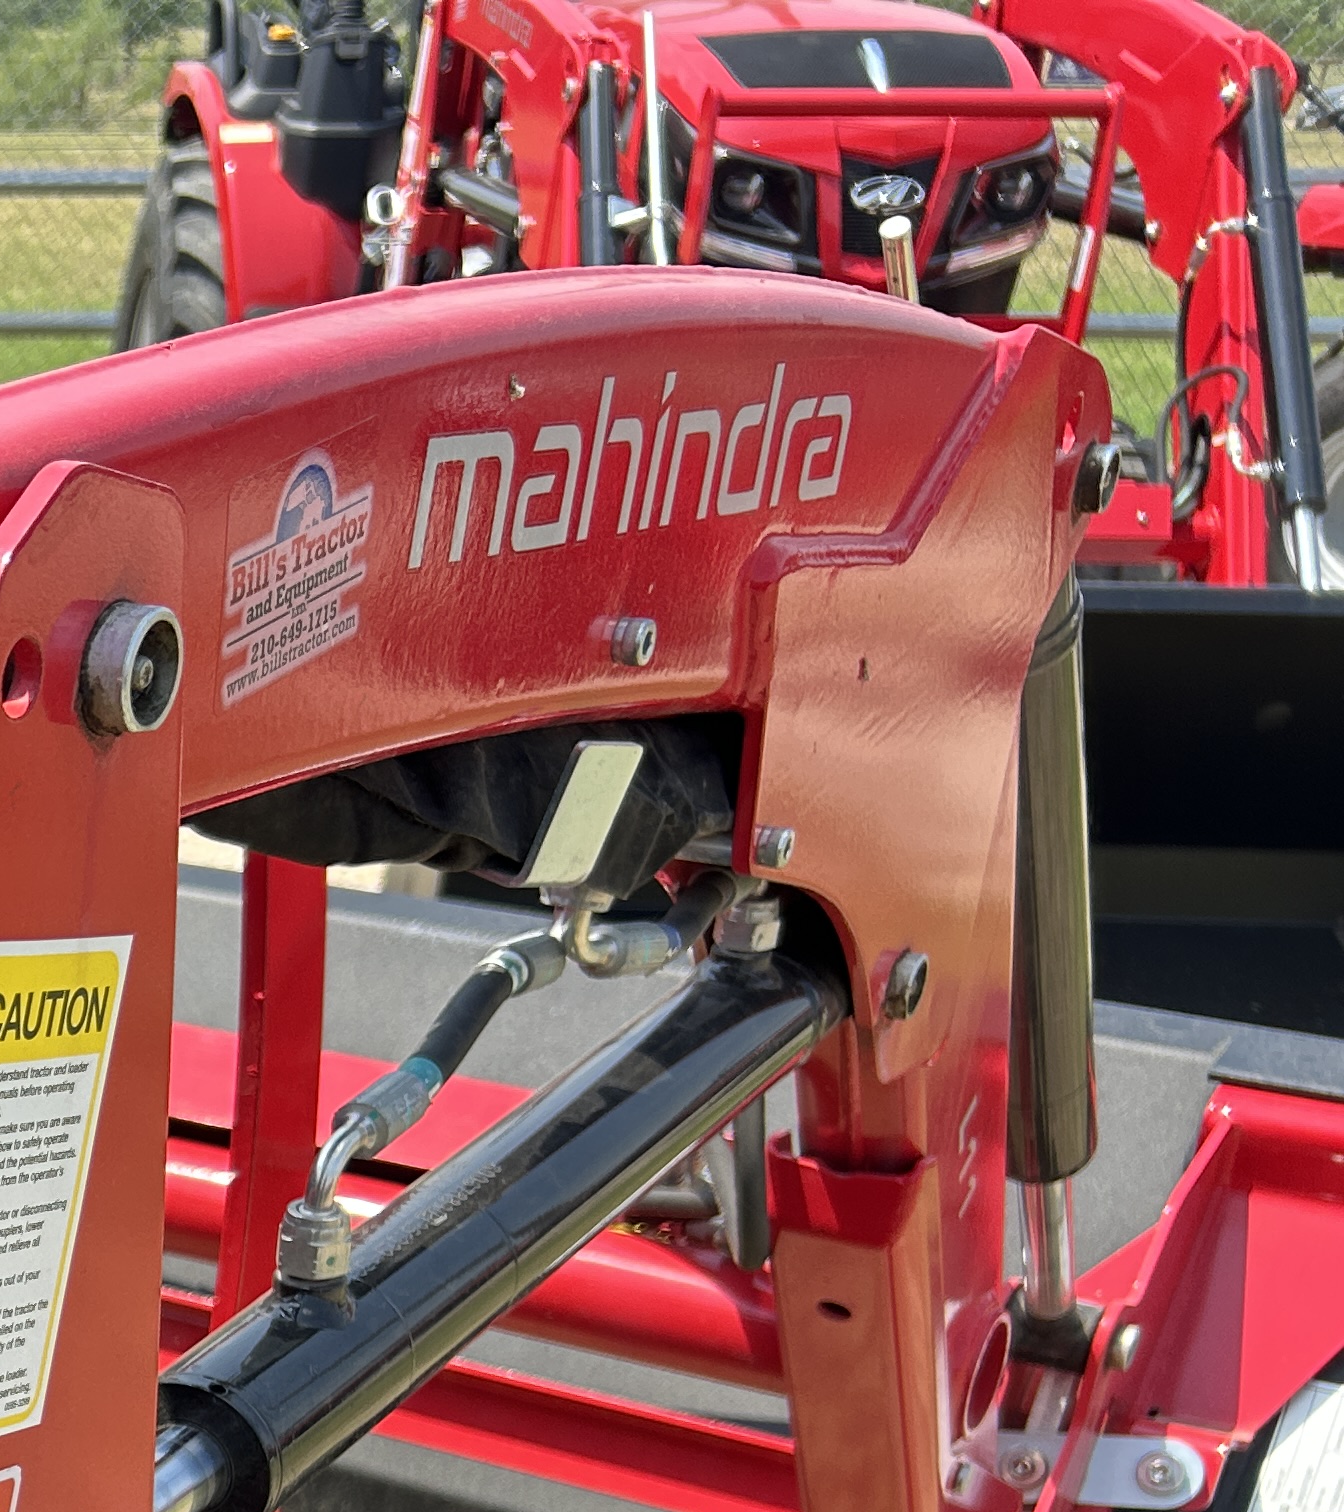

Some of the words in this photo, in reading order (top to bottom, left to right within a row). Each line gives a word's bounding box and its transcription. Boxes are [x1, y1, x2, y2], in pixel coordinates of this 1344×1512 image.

[406, 362, 852, 571] mahindra
[229, 550, 287, 607] Bill's
[291, 510, 369, 574] Tractor
[245, 589, 273, 625] and
[274, 551, 350, 613] Equipment
[225, 612, 357, 699] www.billstractor.com
[250, 599, 339, 666] 210-649-1715
[29, 1065, 54, 1079] tractor
[53, 1062, 68, 1076] and
[67, 1061, 90, 1074] loader
[0, 1174, 17, 1187] from
[17, 1171, 30, 1184] the
[30, 1165, 65, 1184] operator's
[3, 1273, 16, 1287] out
[16, 1270, 25, 1284] of
[23, 1269, 41, 1285] your
